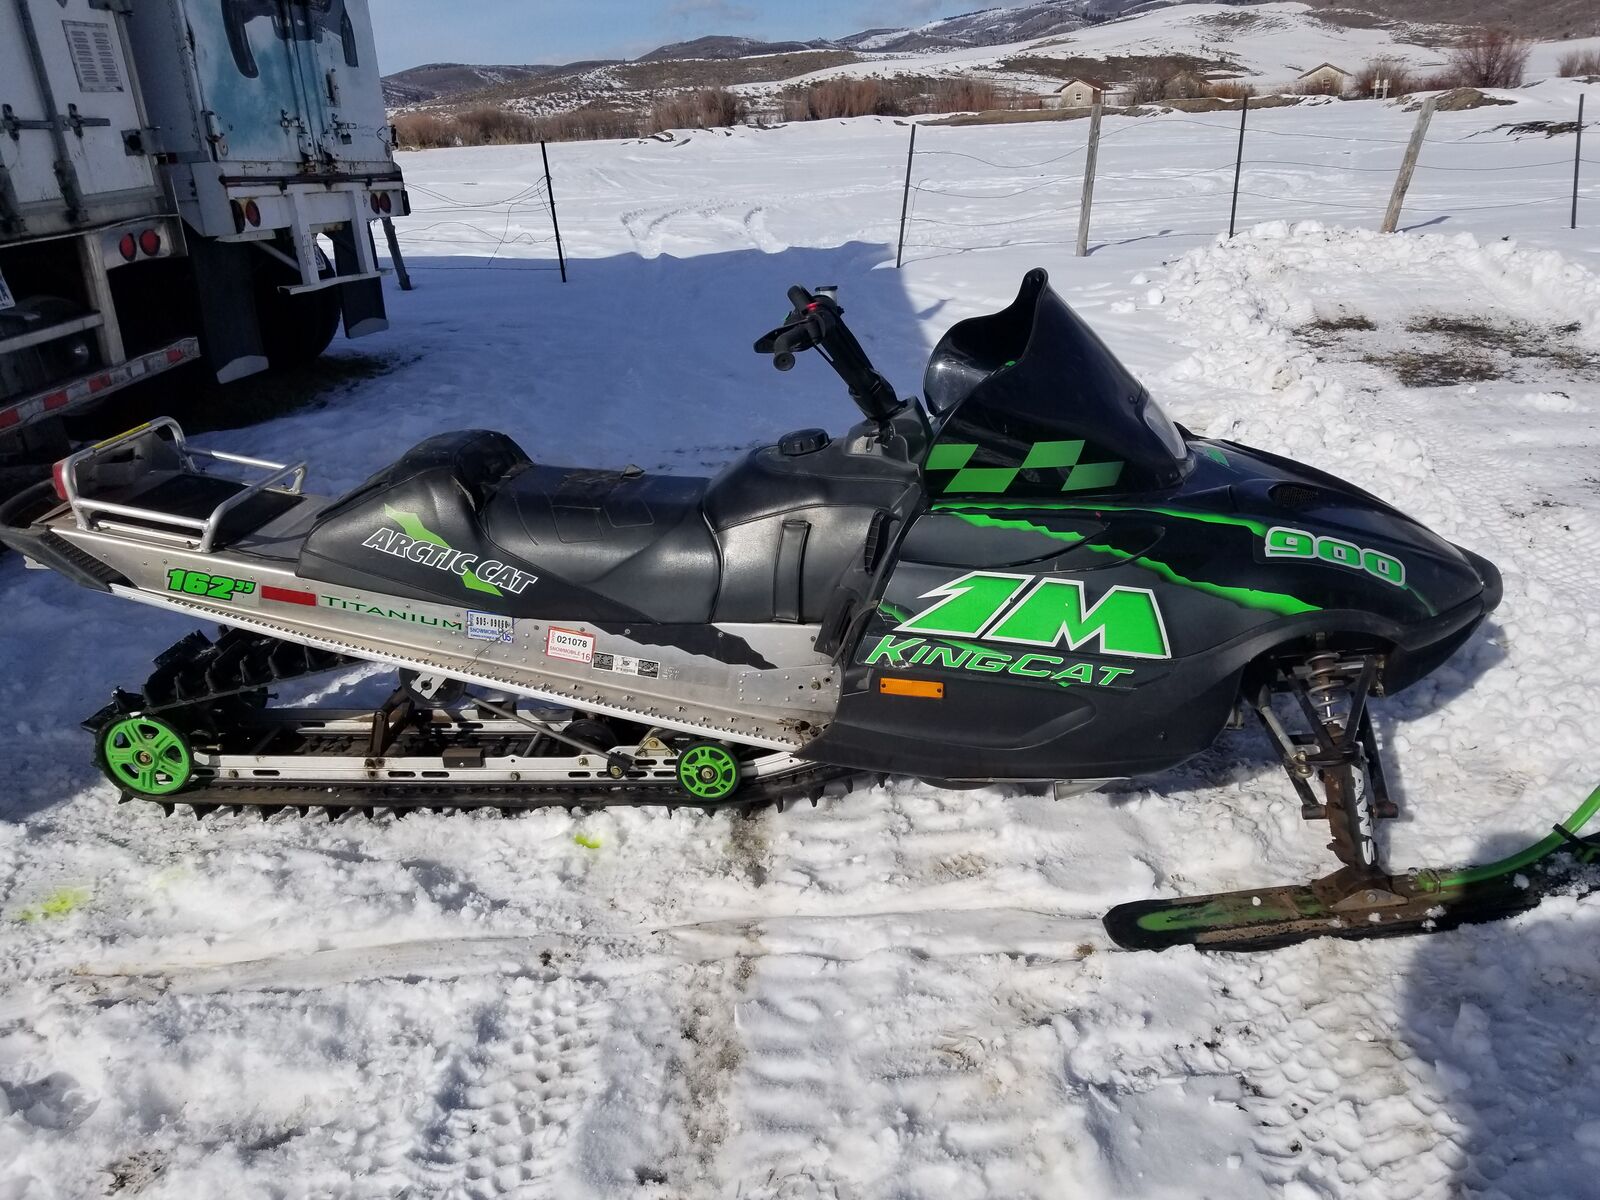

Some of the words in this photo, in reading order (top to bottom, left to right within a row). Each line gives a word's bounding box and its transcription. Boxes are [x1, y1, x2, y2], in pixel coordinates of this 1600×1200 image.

[362, 527, 478, 574] ARCTIC
[474, 558, 538, 595] CAT
[1264, 526, 1406, 586] 900
[320, 594, 464, 631] TITANIUM
[556, 635, 588, 648] 021078
[581, 652, 591, 661] 16
